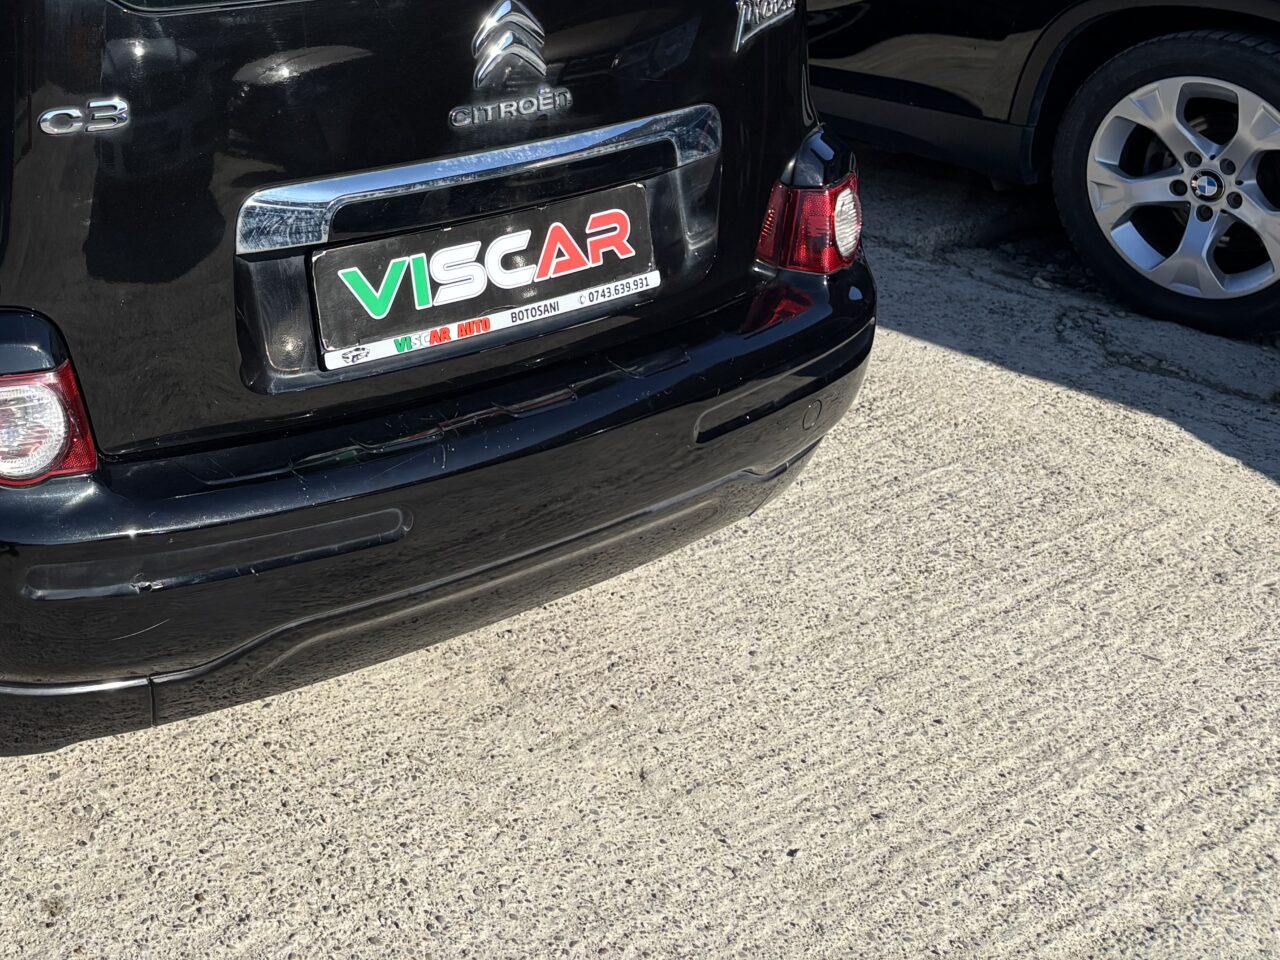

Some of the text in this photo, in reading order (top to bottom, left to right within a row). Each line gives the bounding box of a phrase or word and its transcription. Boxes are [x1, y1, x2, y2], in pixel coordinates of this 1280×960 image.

[37, 98, 129, 135] C3
[337, 208, 636, 320] VISCAR
[394, 276, 650, 353] VISCAR AUTO BOTOSANI 0743.639.931
